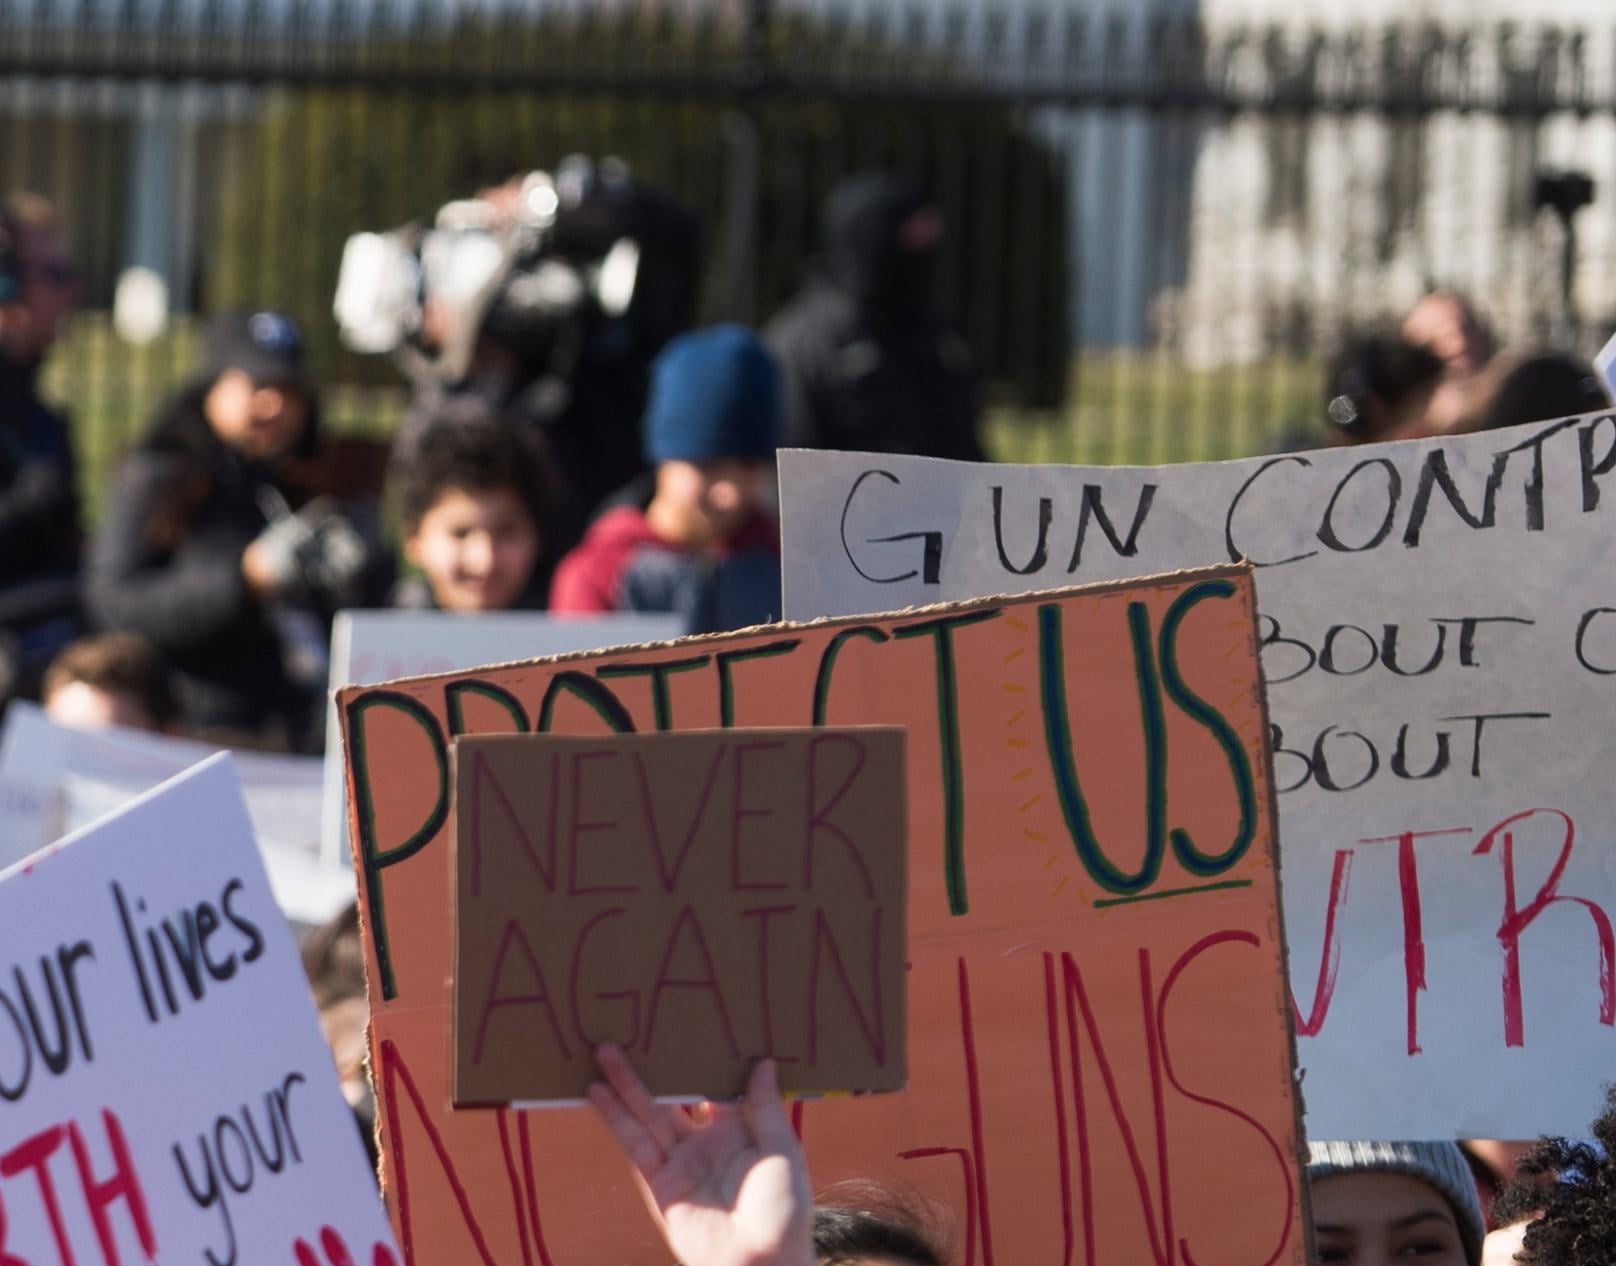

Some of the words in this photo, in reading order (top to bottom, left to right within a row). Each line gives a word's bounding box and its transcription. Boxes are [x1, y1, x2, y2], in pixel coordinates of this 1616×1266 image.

[840, 469, 1159, 584] GUN
[472, 734, 878, 900] NEVER
[1037, 579, 1258, 895] US
[109, 878, 265, 1024] lives
[472, 903, 887, 1068] AGAIN
